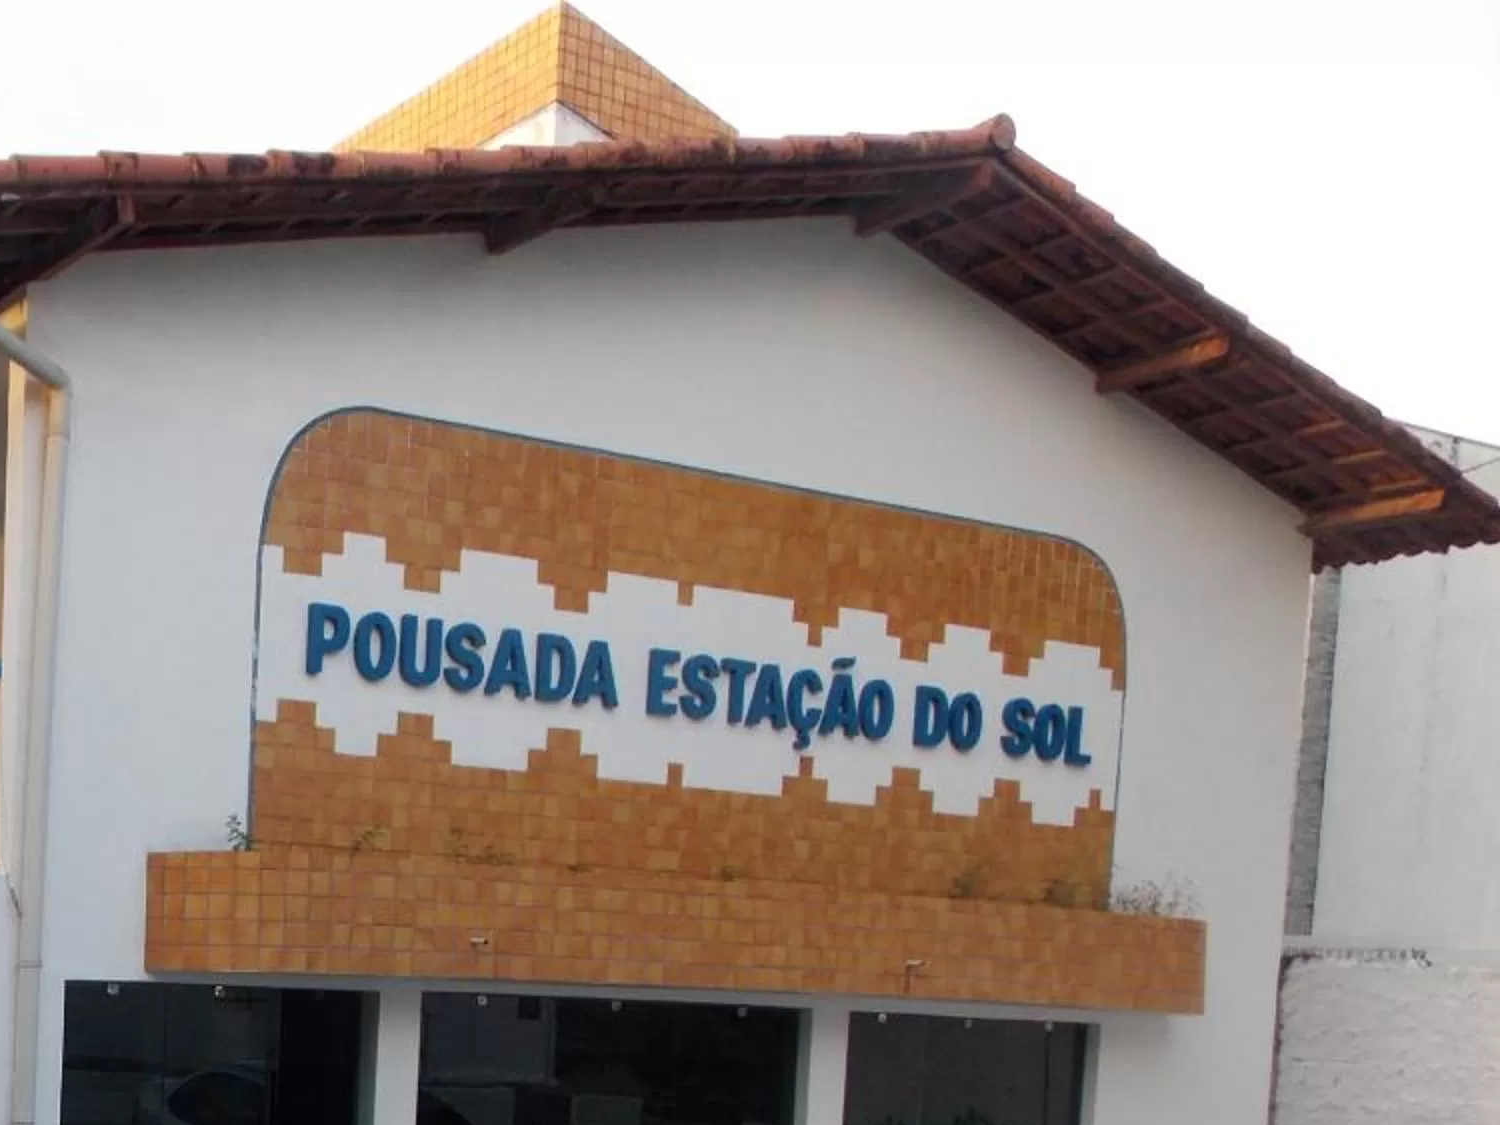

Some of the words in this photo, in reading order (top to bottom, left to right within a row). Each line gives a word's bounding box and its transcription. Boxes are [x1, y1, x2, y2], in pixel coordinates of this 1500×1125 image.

[305, 602, 619, 708] POUSADA
[645, 647, 895, 749] ESTAÇÃO
[912, 684, 984, 750] DO
[1001, 698, 1092, 767] SOL
